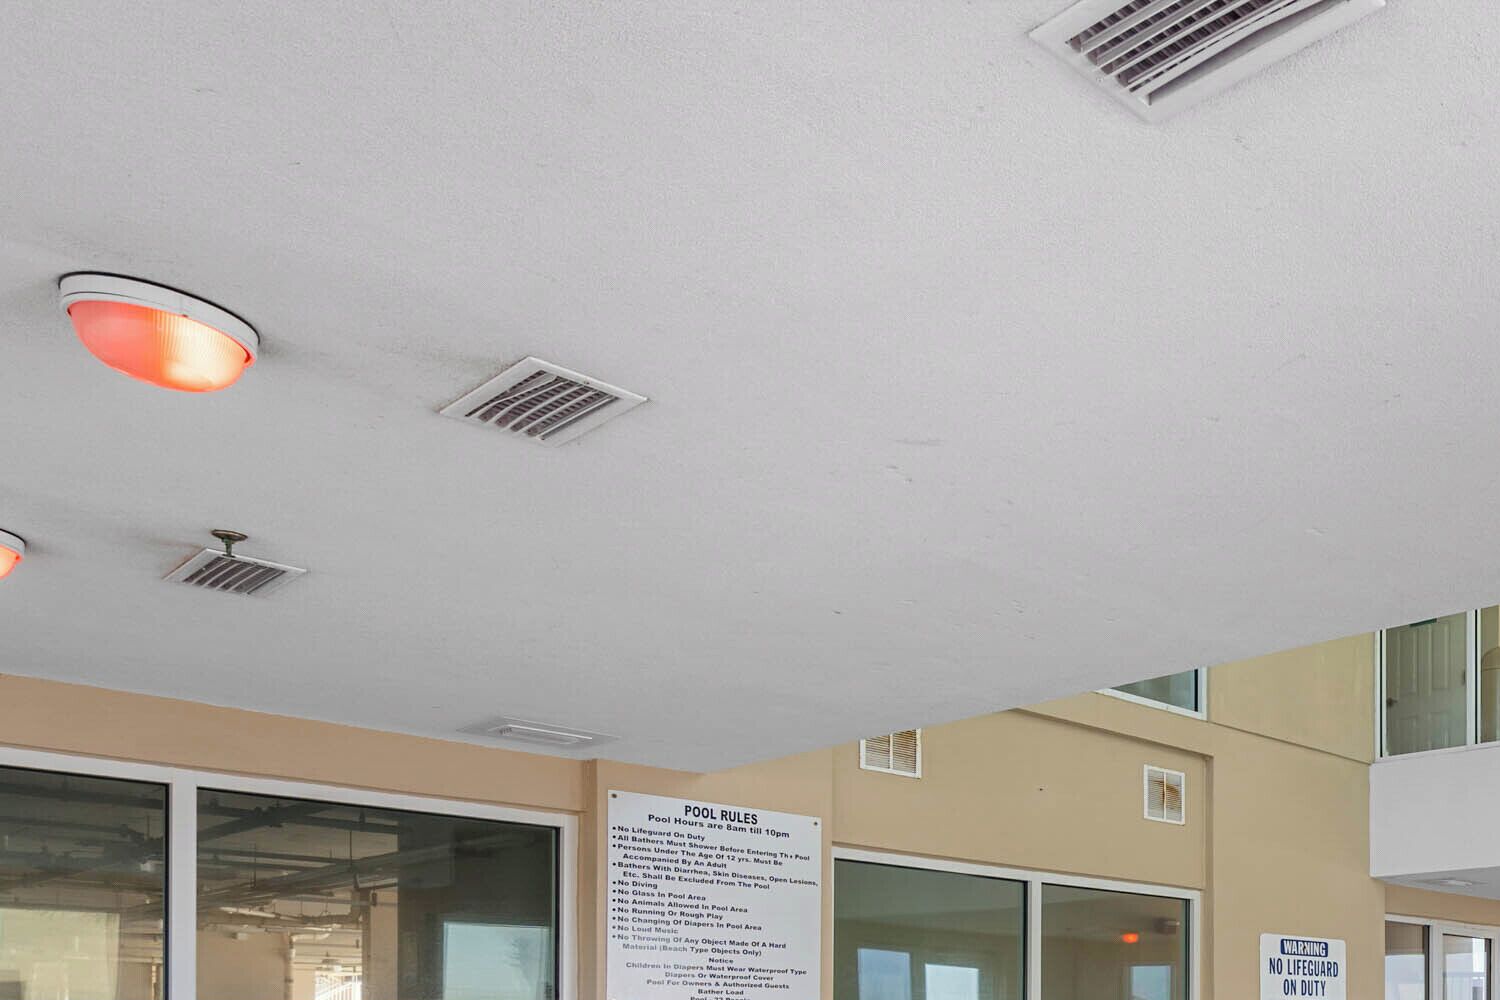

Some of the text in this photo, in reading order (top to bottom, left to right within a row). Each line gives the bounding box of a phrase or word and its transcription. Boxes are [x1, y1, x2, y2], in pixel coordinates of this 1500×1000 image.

[685, 805, 758, 825] POOL RULES
[648, 814, 671, 824] Pool
[674, 817, 705, 828] Hours
[726, 824, 747, 833] 8am
[750, 827, 762, 835] till
[765, 829, 790, 839] 10pm
[632, 827, 672, 837] Lifeguard
[687, 833, 706, 842] Duty
[618, 843, 652, 853] Persons
[654, 847, 679, 856] Under
[698, 852, 714, 860] Age
[631, 836, 664, 845] Bathers
[666, 840, 687, 848] Must
[688, 842, 718, 851] Shower
[719, 846, 745, 854] Before
[747, 849, 778, 859] Entering
[623, 853, 680, 864] Accompanied
[681, 859, 692, 867] By
[706, 861, 727, 869] Adult
[618, 861, 651, 870] Bathers
[653, 865, 672, 873] With
[769, 876, 788, 884] Open
[632, 881, 658, 890] Diving
[678, 876, 715, 885] Excluded
[716, 879, 736, 887] From
[632, 890, 656, 898] Glass
[687, 894, 707, 902] Area
[632, 899, 665, 907] Animals
[667, 902, 700, 910] Allowed
[632, 908, 666, 917] Running
[679, 911, 705, 920] Rough
[706, 913, 724, 921] Play
[631, 917, 671, 927] Changing
[655, 927, 679, 935] Music
[684, 938, 700, 946] Any
[701, 938, 727, 947] Object
[1283, 940, 1326, 956] WARNING
[711, 948, 741, 956] Objects
[742, 949, 762, 957] Only)
[748, 967, 789, 975] Waterproof
[1269, 957, 1339, 977] NO LIFEGUARD
[1283, 978, 1327, 997] ON DUTY
